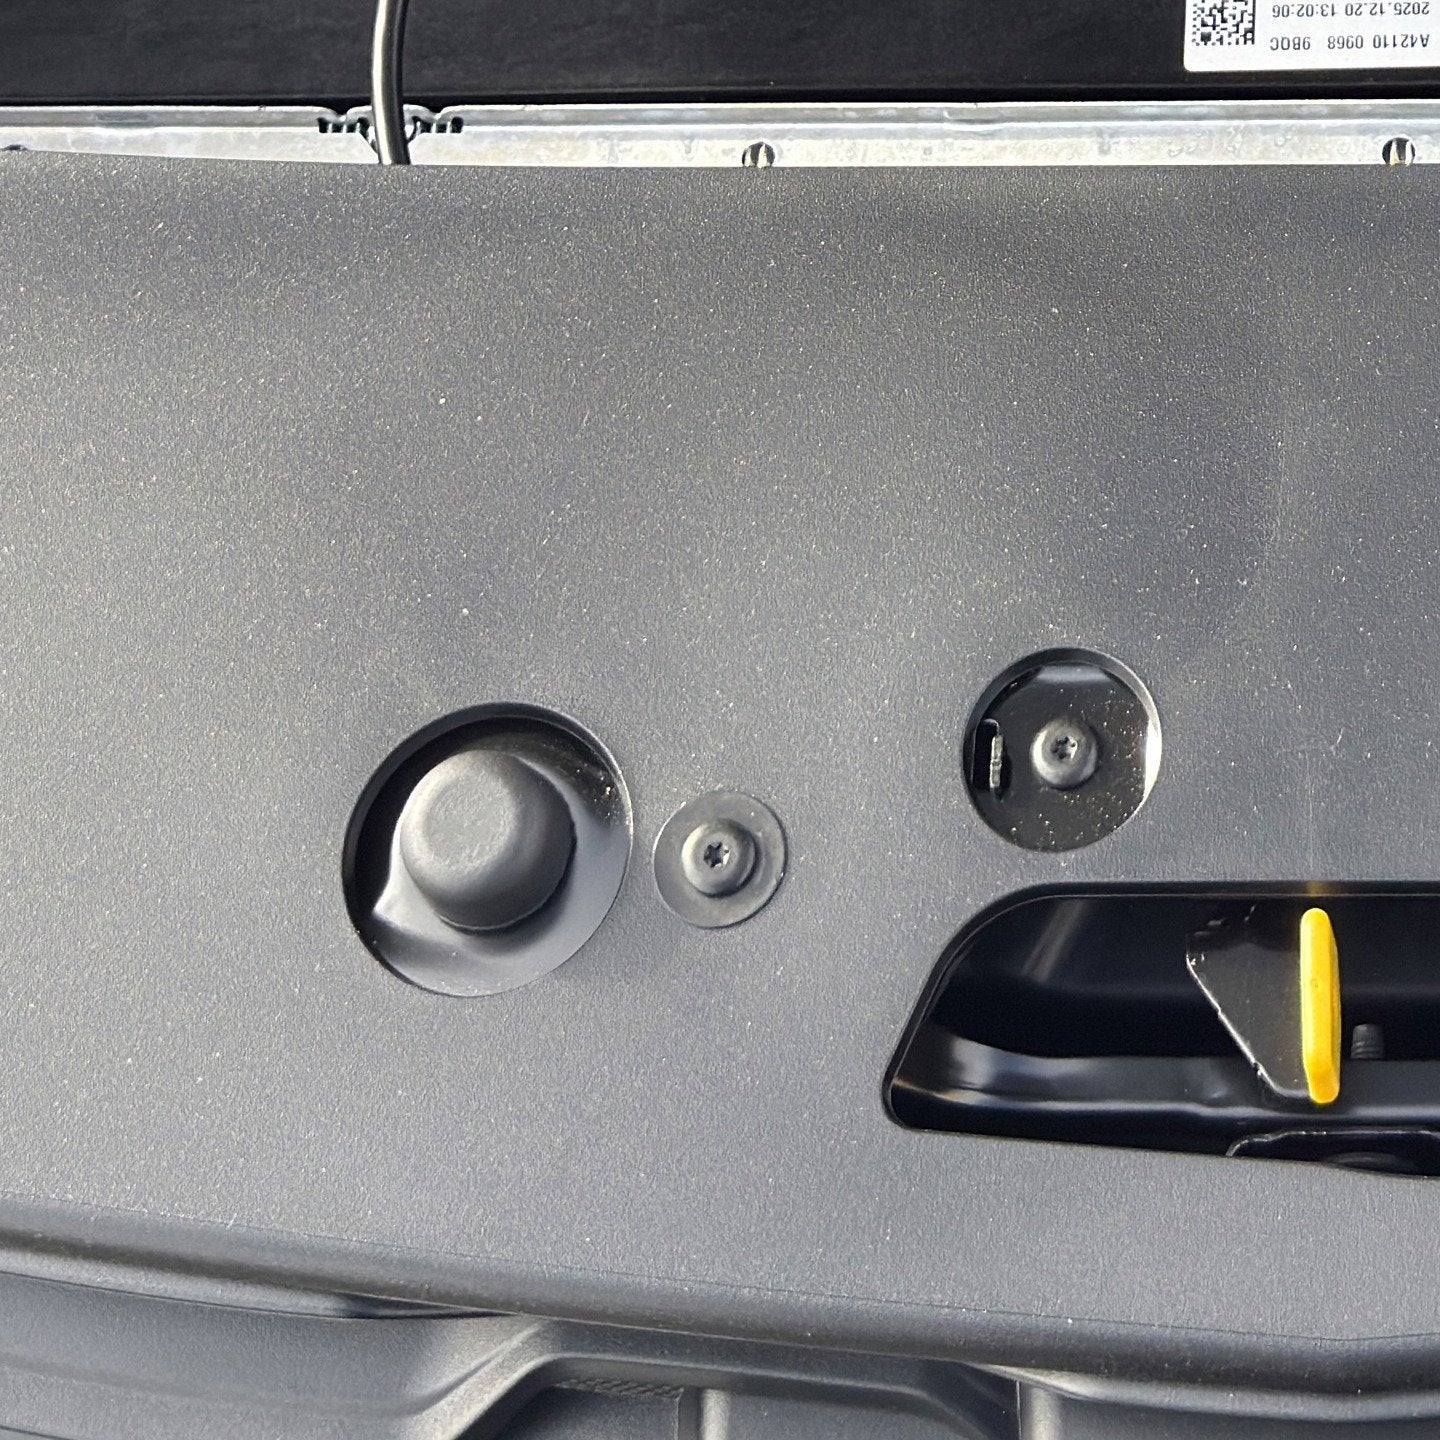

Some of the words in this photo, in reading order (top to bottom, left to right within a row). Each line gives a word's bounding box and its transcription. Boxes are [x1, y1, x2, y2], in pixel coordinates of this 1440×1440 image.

[1271, 3, 1336, 18] 13:02:06
[1344, 1, 1430, 16] 2025.12.20
[1269, 36, 1311, 51] 9BQC
[1326, 35, 1364, 50] 0968
[1372, 33, 1430, 49] A42110
